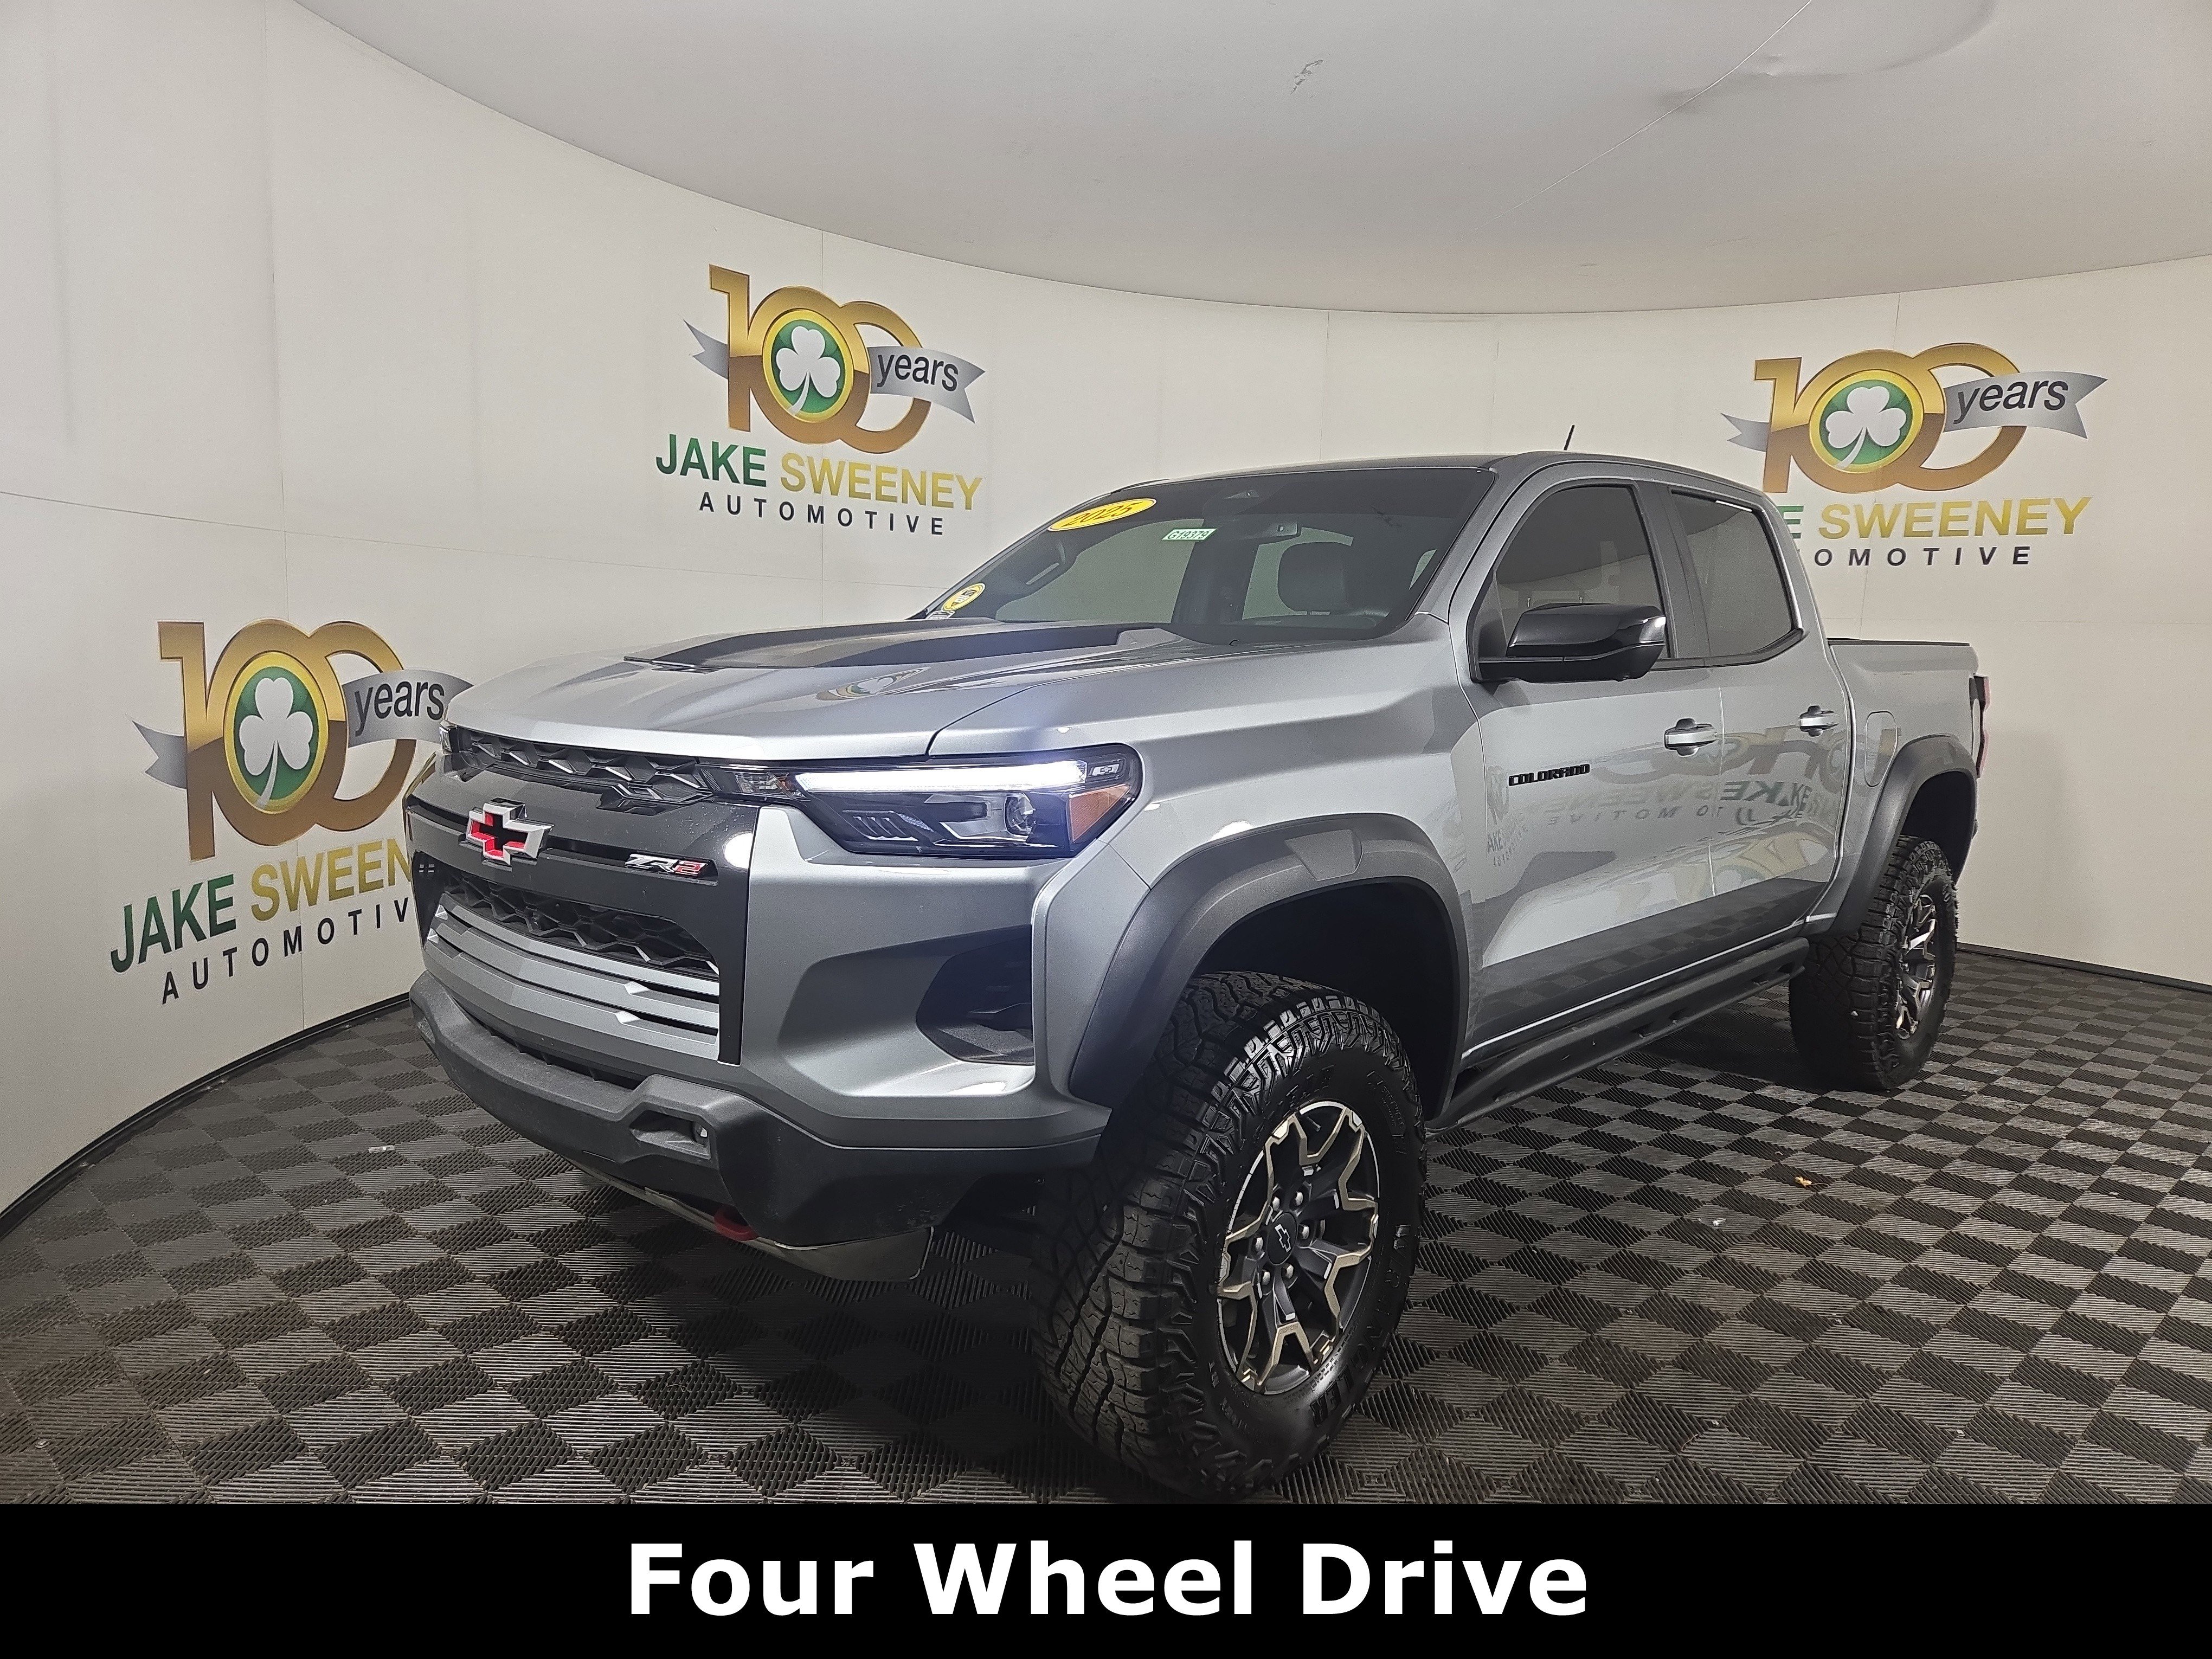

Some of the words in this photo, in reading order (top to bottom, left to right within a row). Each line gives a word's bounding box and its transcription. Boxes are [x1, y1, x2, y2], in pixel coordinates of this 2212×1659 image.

[709, 264, 932, 454] 100
[878, 353, 959, 391] years
[1754, 343, 2027, 493] 100
[1953, 379, 2068, 425] years
[656, 434, 767, 487] JAKE
[780, 453, 982, 510] SWEENEY
[699, 491, 943, 536] AUTOMOTIVE
[1060, 501, 1143, 528] 2025
[1167, 531, 1210, 539] G19379
[1819, 497, 2092, 539] SWEENEY
[1814, 546, 2030, 567] OMOTIVE
[354, 680, 445, 737] years
[157, 619, 417, 860] 100
[1508, 763, 1590, 786] COLORADO
[625, 853, 709, 876] ZR2
[111, 873, 237, 973] JAKE
[250, 838, 411, 921] SWEEN
[162, 897, 408, 1005] AUTOMOTIV
